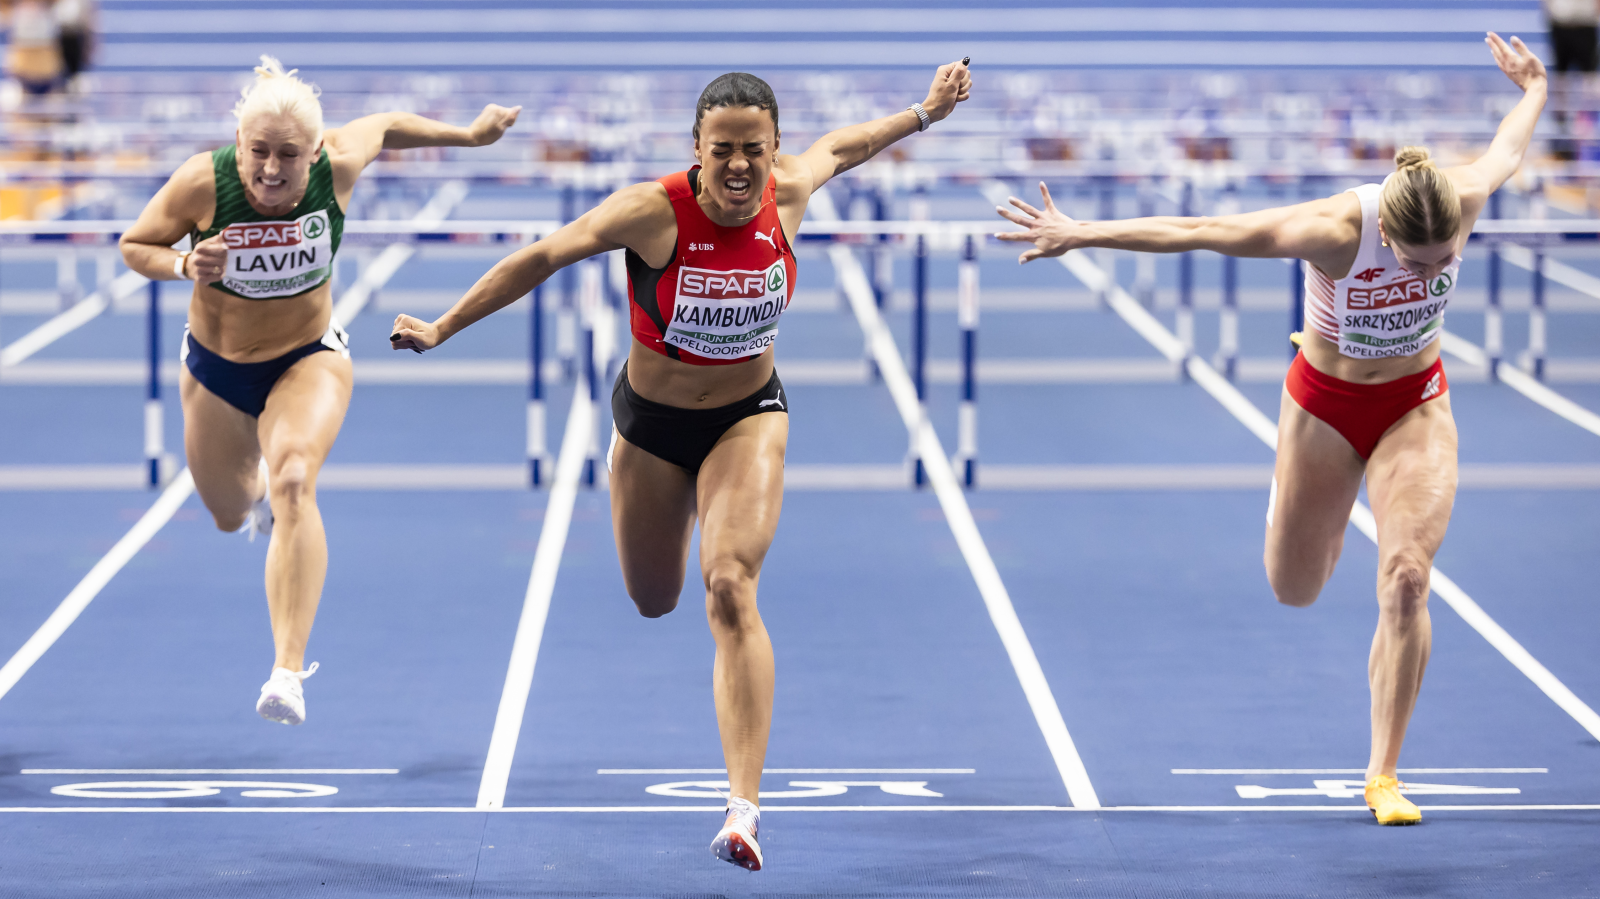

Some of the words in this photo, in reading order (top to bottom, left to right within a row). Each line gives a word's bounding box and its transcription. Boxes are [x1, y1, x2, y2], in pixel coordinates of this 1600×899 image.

[224, 226, 301, 246] SPAR
[698, 243, 714, 251] UBS
[235, 246, 316, 272] LAVIN
[682, 274, 765, 296] SPAR
[1349, 280, 1425, 307] SPAR
[674, 295, 784, 328] KAMBUNDJI
[670, 335, 748, 355] APELDOORN
[699, 334, 724, 343] RUN
[725, 330, 758, 343] CLEAN
[1370, 337, 1394, 347] RUN
[1344, 342, 1419, 357] APELDOORN
